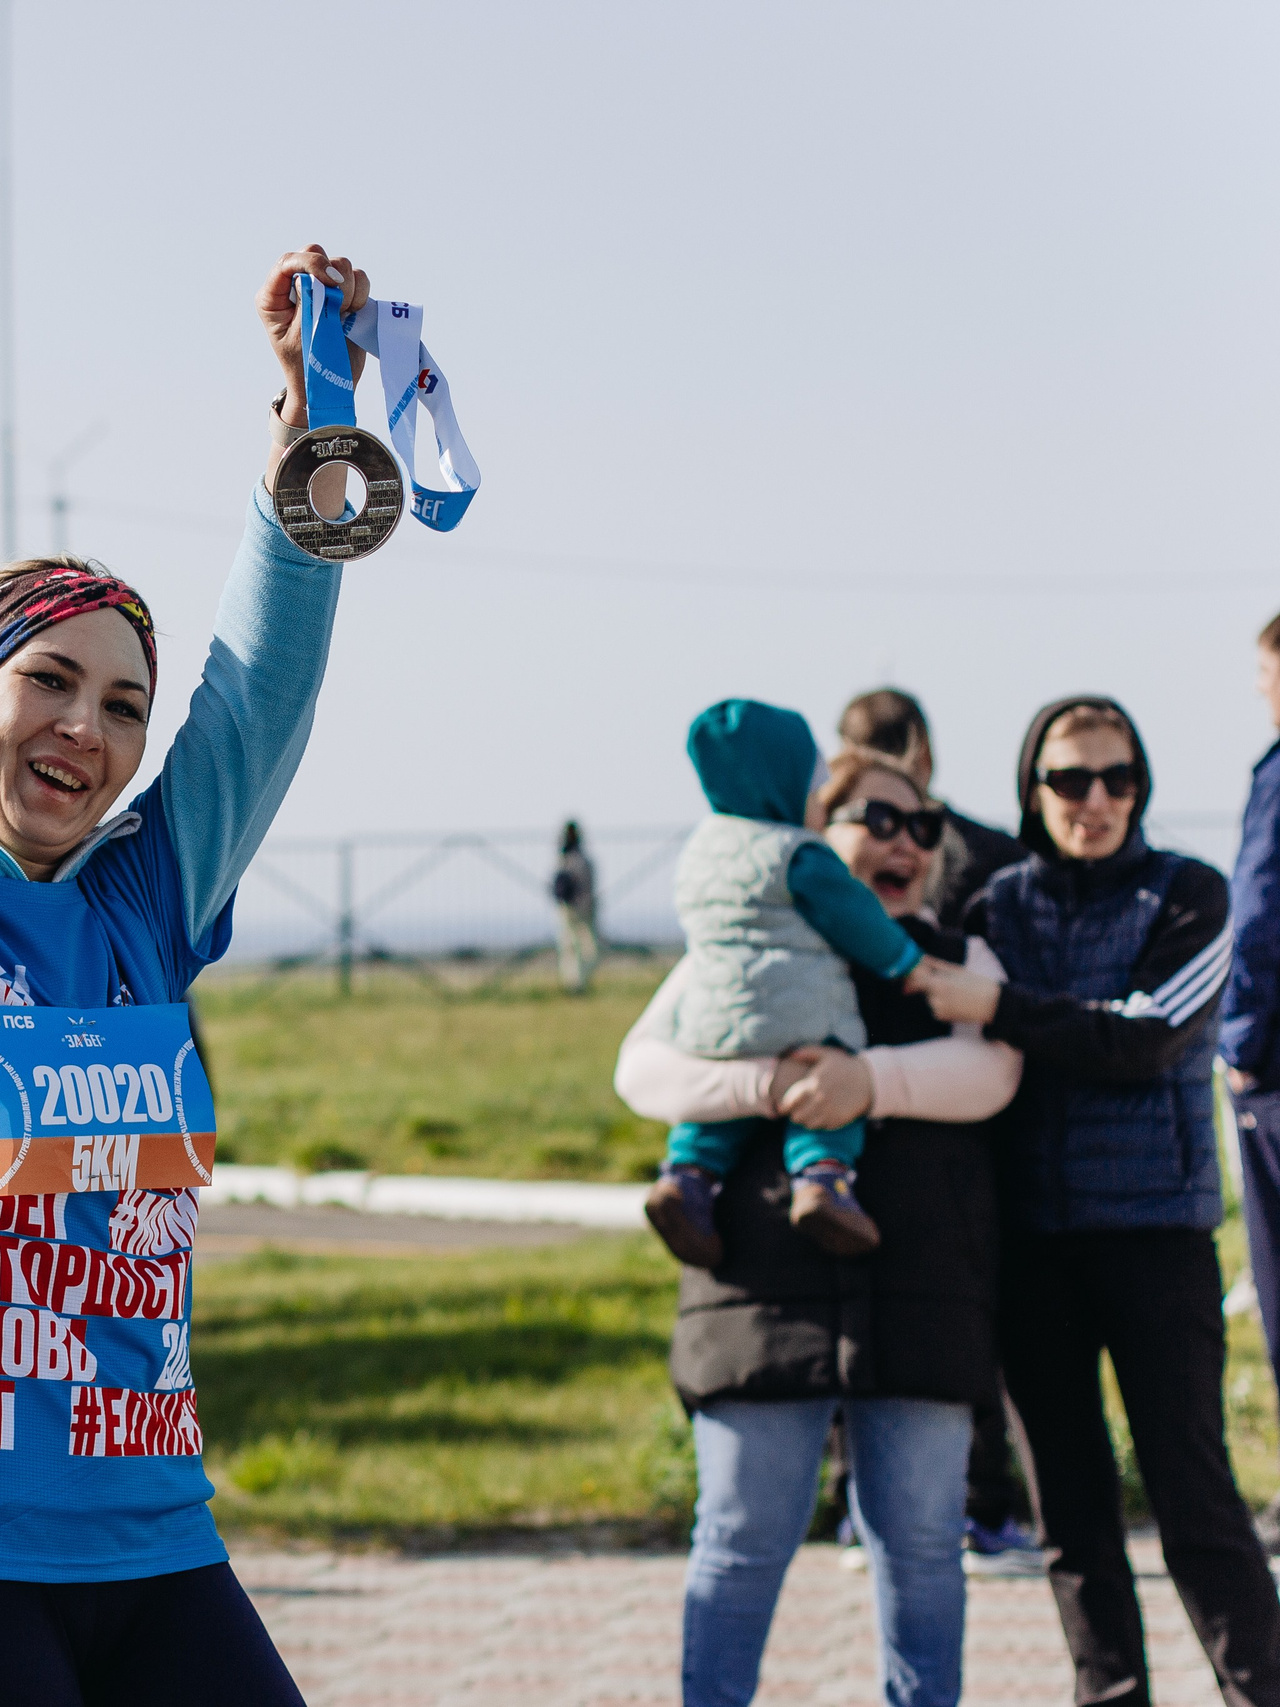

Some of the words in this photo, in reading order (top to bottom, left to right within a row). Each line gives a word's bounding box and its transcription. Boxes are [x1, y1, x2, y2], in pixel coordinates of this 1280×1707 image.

[321, 367, 354, 391] #СВОБОД
[3, 1015, 35, 1029] ПСБ
[32, 1063, 174, 1126] 20020
